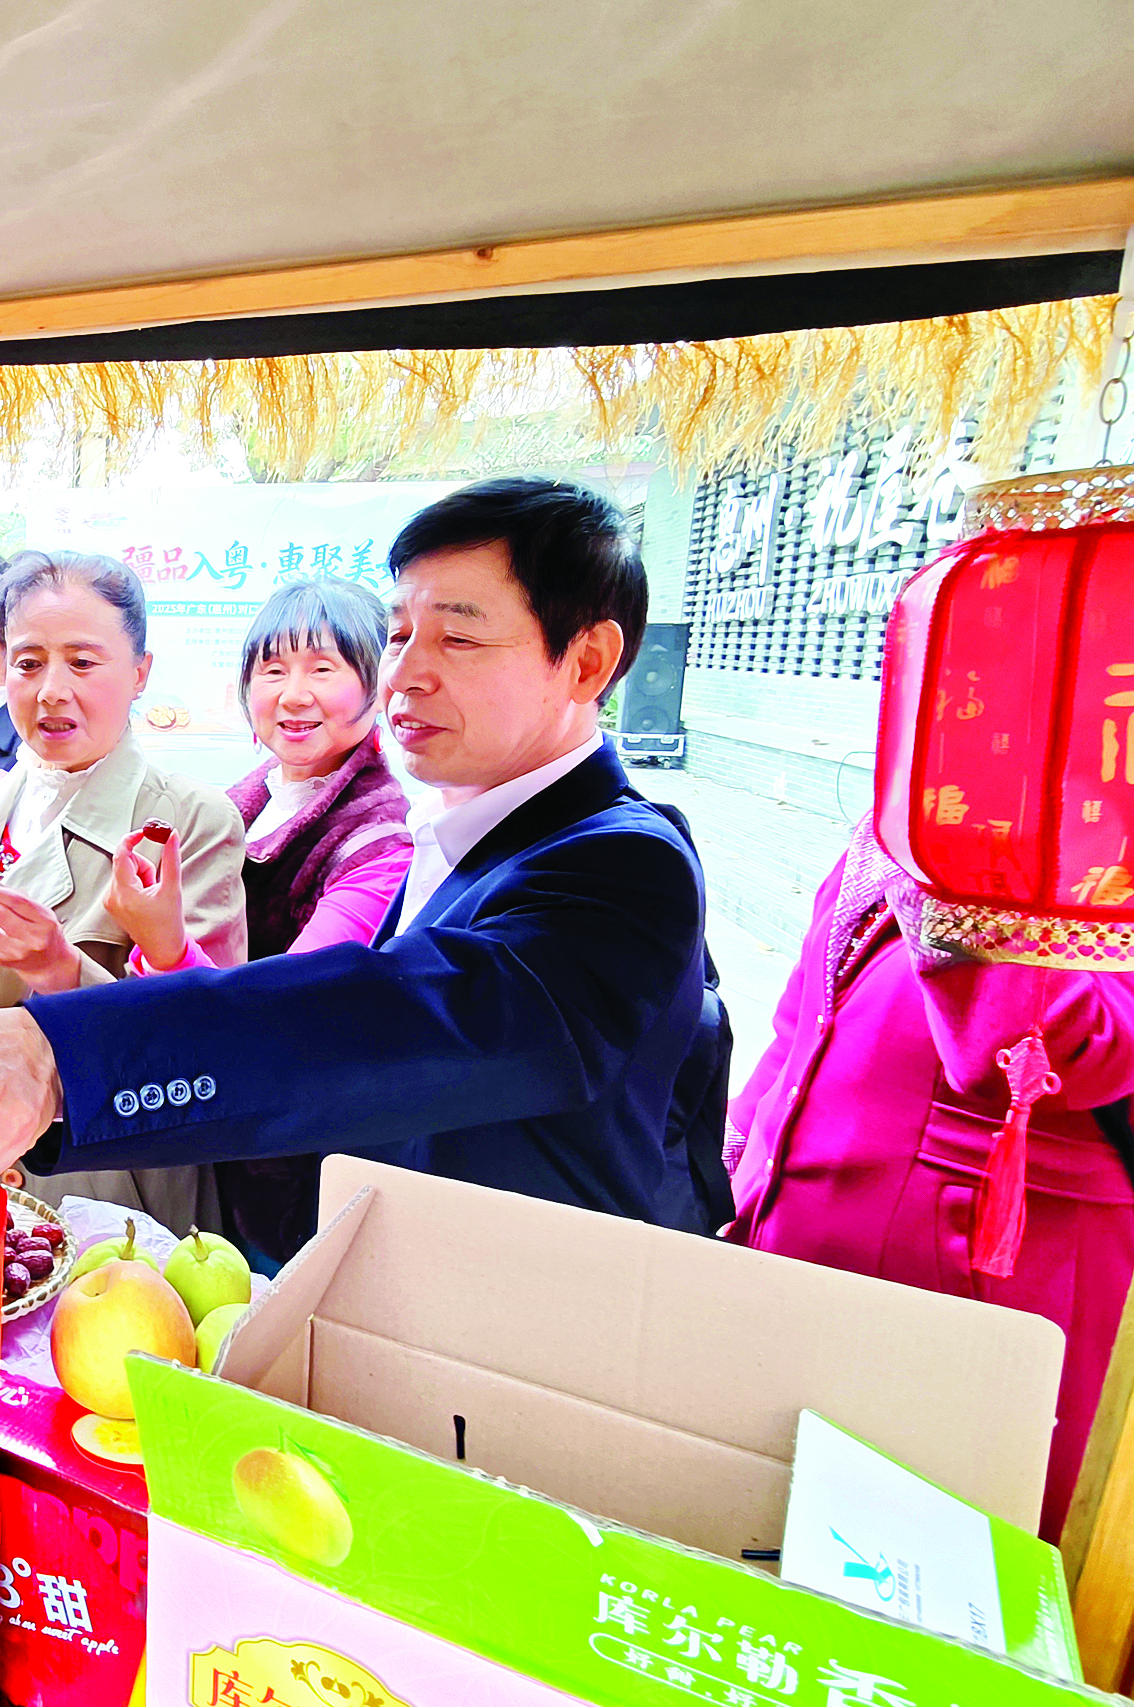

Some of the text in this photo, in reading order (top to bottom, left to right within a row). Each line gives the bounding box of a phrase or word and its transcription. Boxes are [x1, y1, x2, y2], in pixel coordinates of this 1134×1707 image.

[704, 585, 771, 622] HUIZHOU
[1071, 865, 1134, 906] 福
[600, 1573, 803, 1655] KORLA PEAR
[80, 1637, 119, 1656] apple
